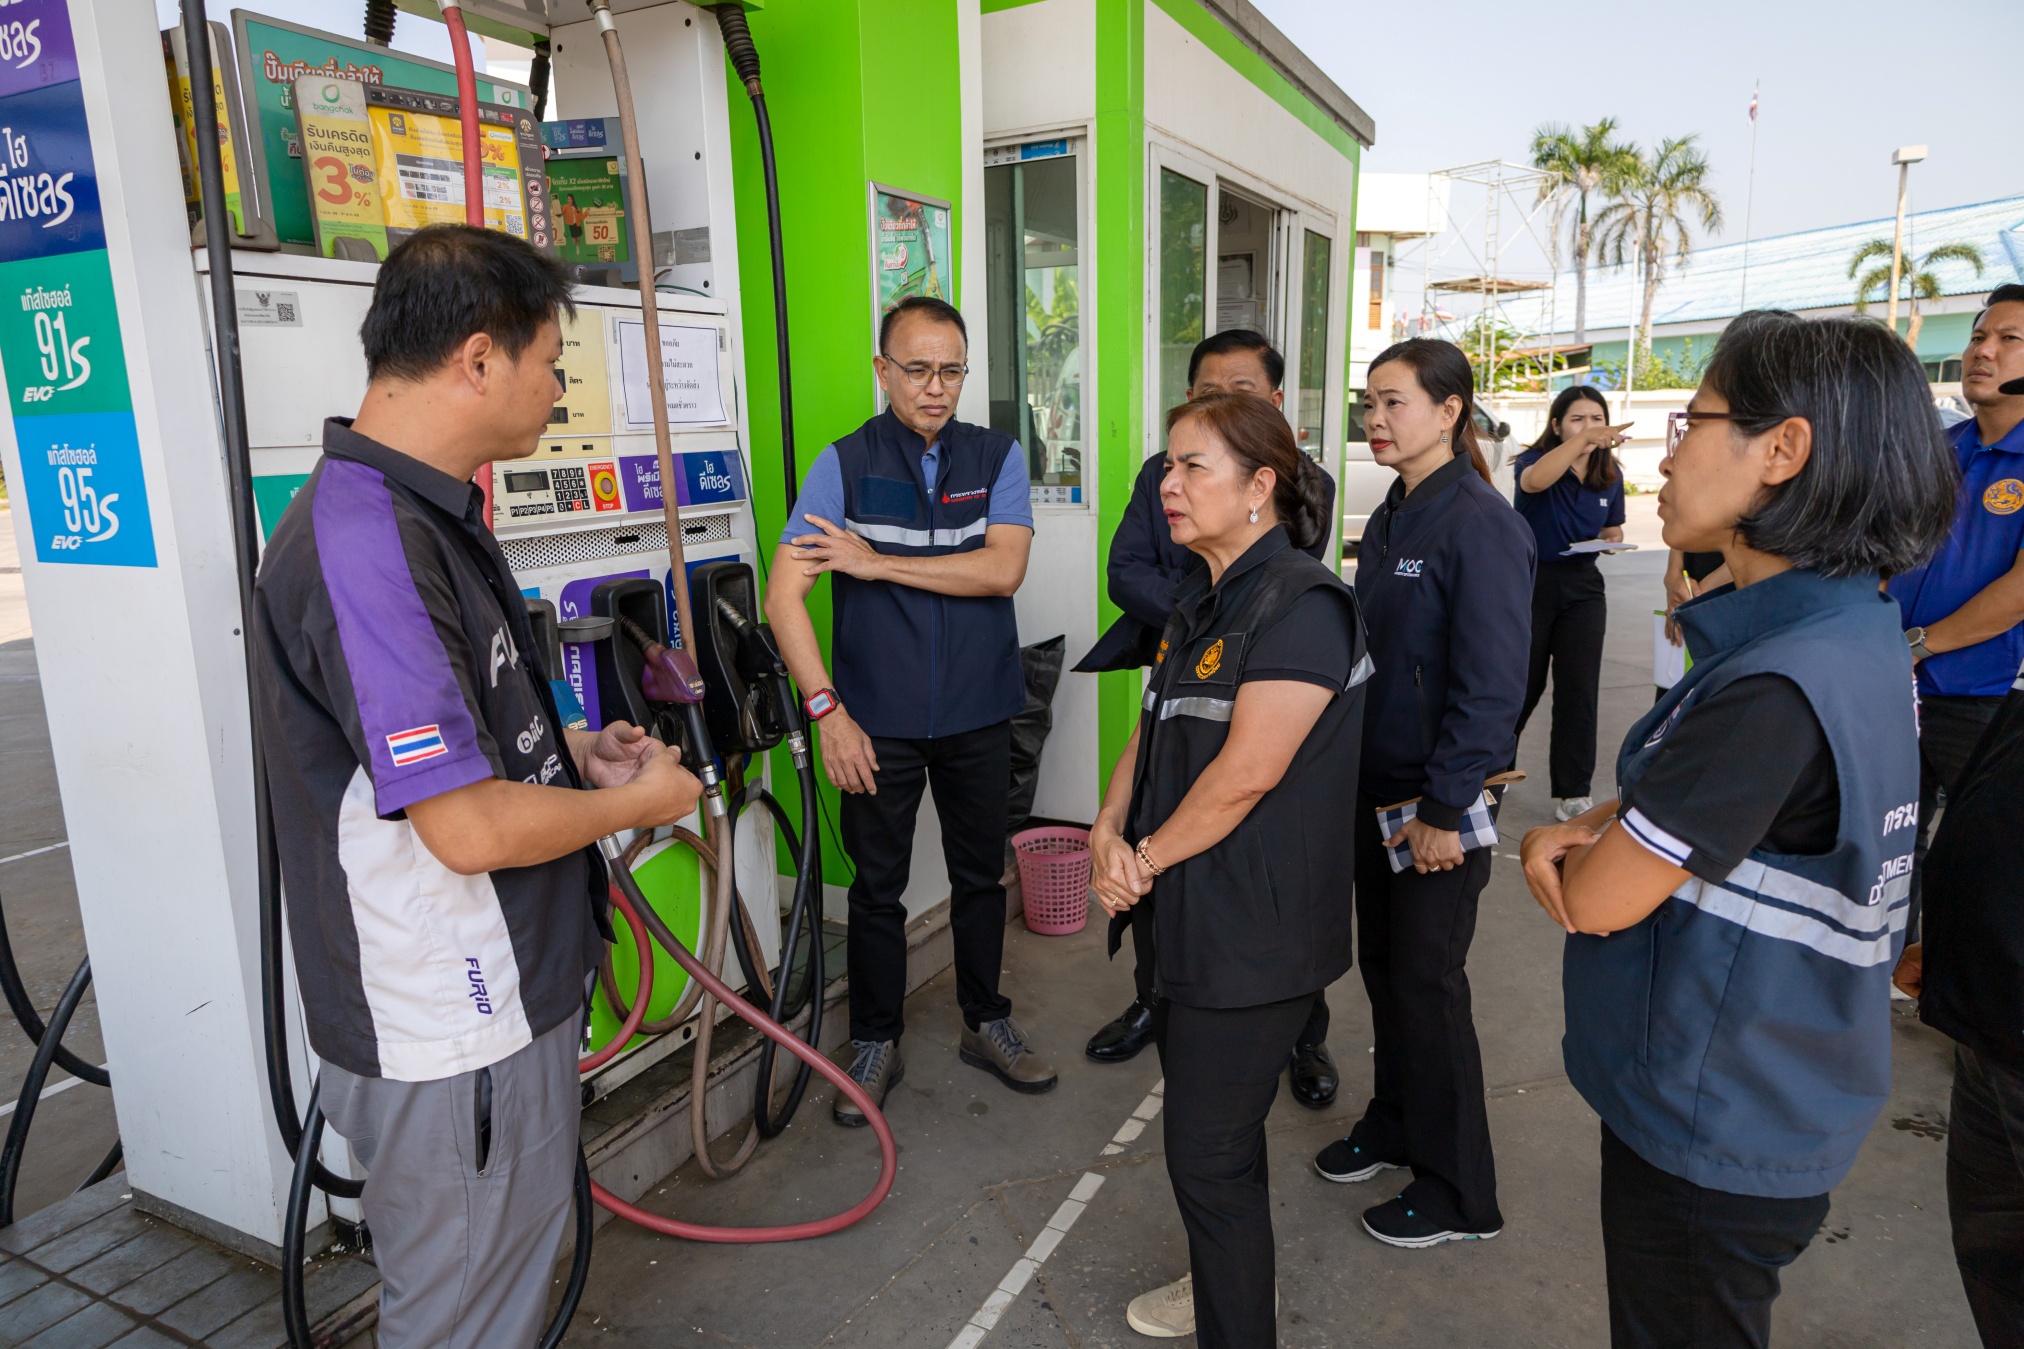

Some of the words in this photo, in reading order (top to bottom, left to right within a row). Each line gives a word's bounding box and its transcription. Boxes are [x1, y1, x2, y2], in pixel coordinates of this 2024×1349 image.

[313, 102, 354, 115] bangchak
[307, 124, 369, 143] รับเครดิต
[2, 127, 28, 169] ไฮ
[310, 141, 371, 159] เงินคืนสูงสุด
[497, 182, 510, 190] 2%
[499, 196, 511, 205] 2%
[593, 225, 609, 240] 50
[21, 283, 73, 311] แก๊สโซฮอล์
[569, 376, 583, 384] ลิตร
[23, 386, 55, 402] EVO
[47, 443, 97, 465] แก๊สโซฮอล์
[634, 463, 643, 475] ไฮ
[704, 460, 714, 474] ไฮ
[637, 472, 661, 483] พรีเมี
[51, 535, 83, 550] EVO
[1396, 558, 1423, 573] MOC
[1882, 801, 1919, 837] กรม
